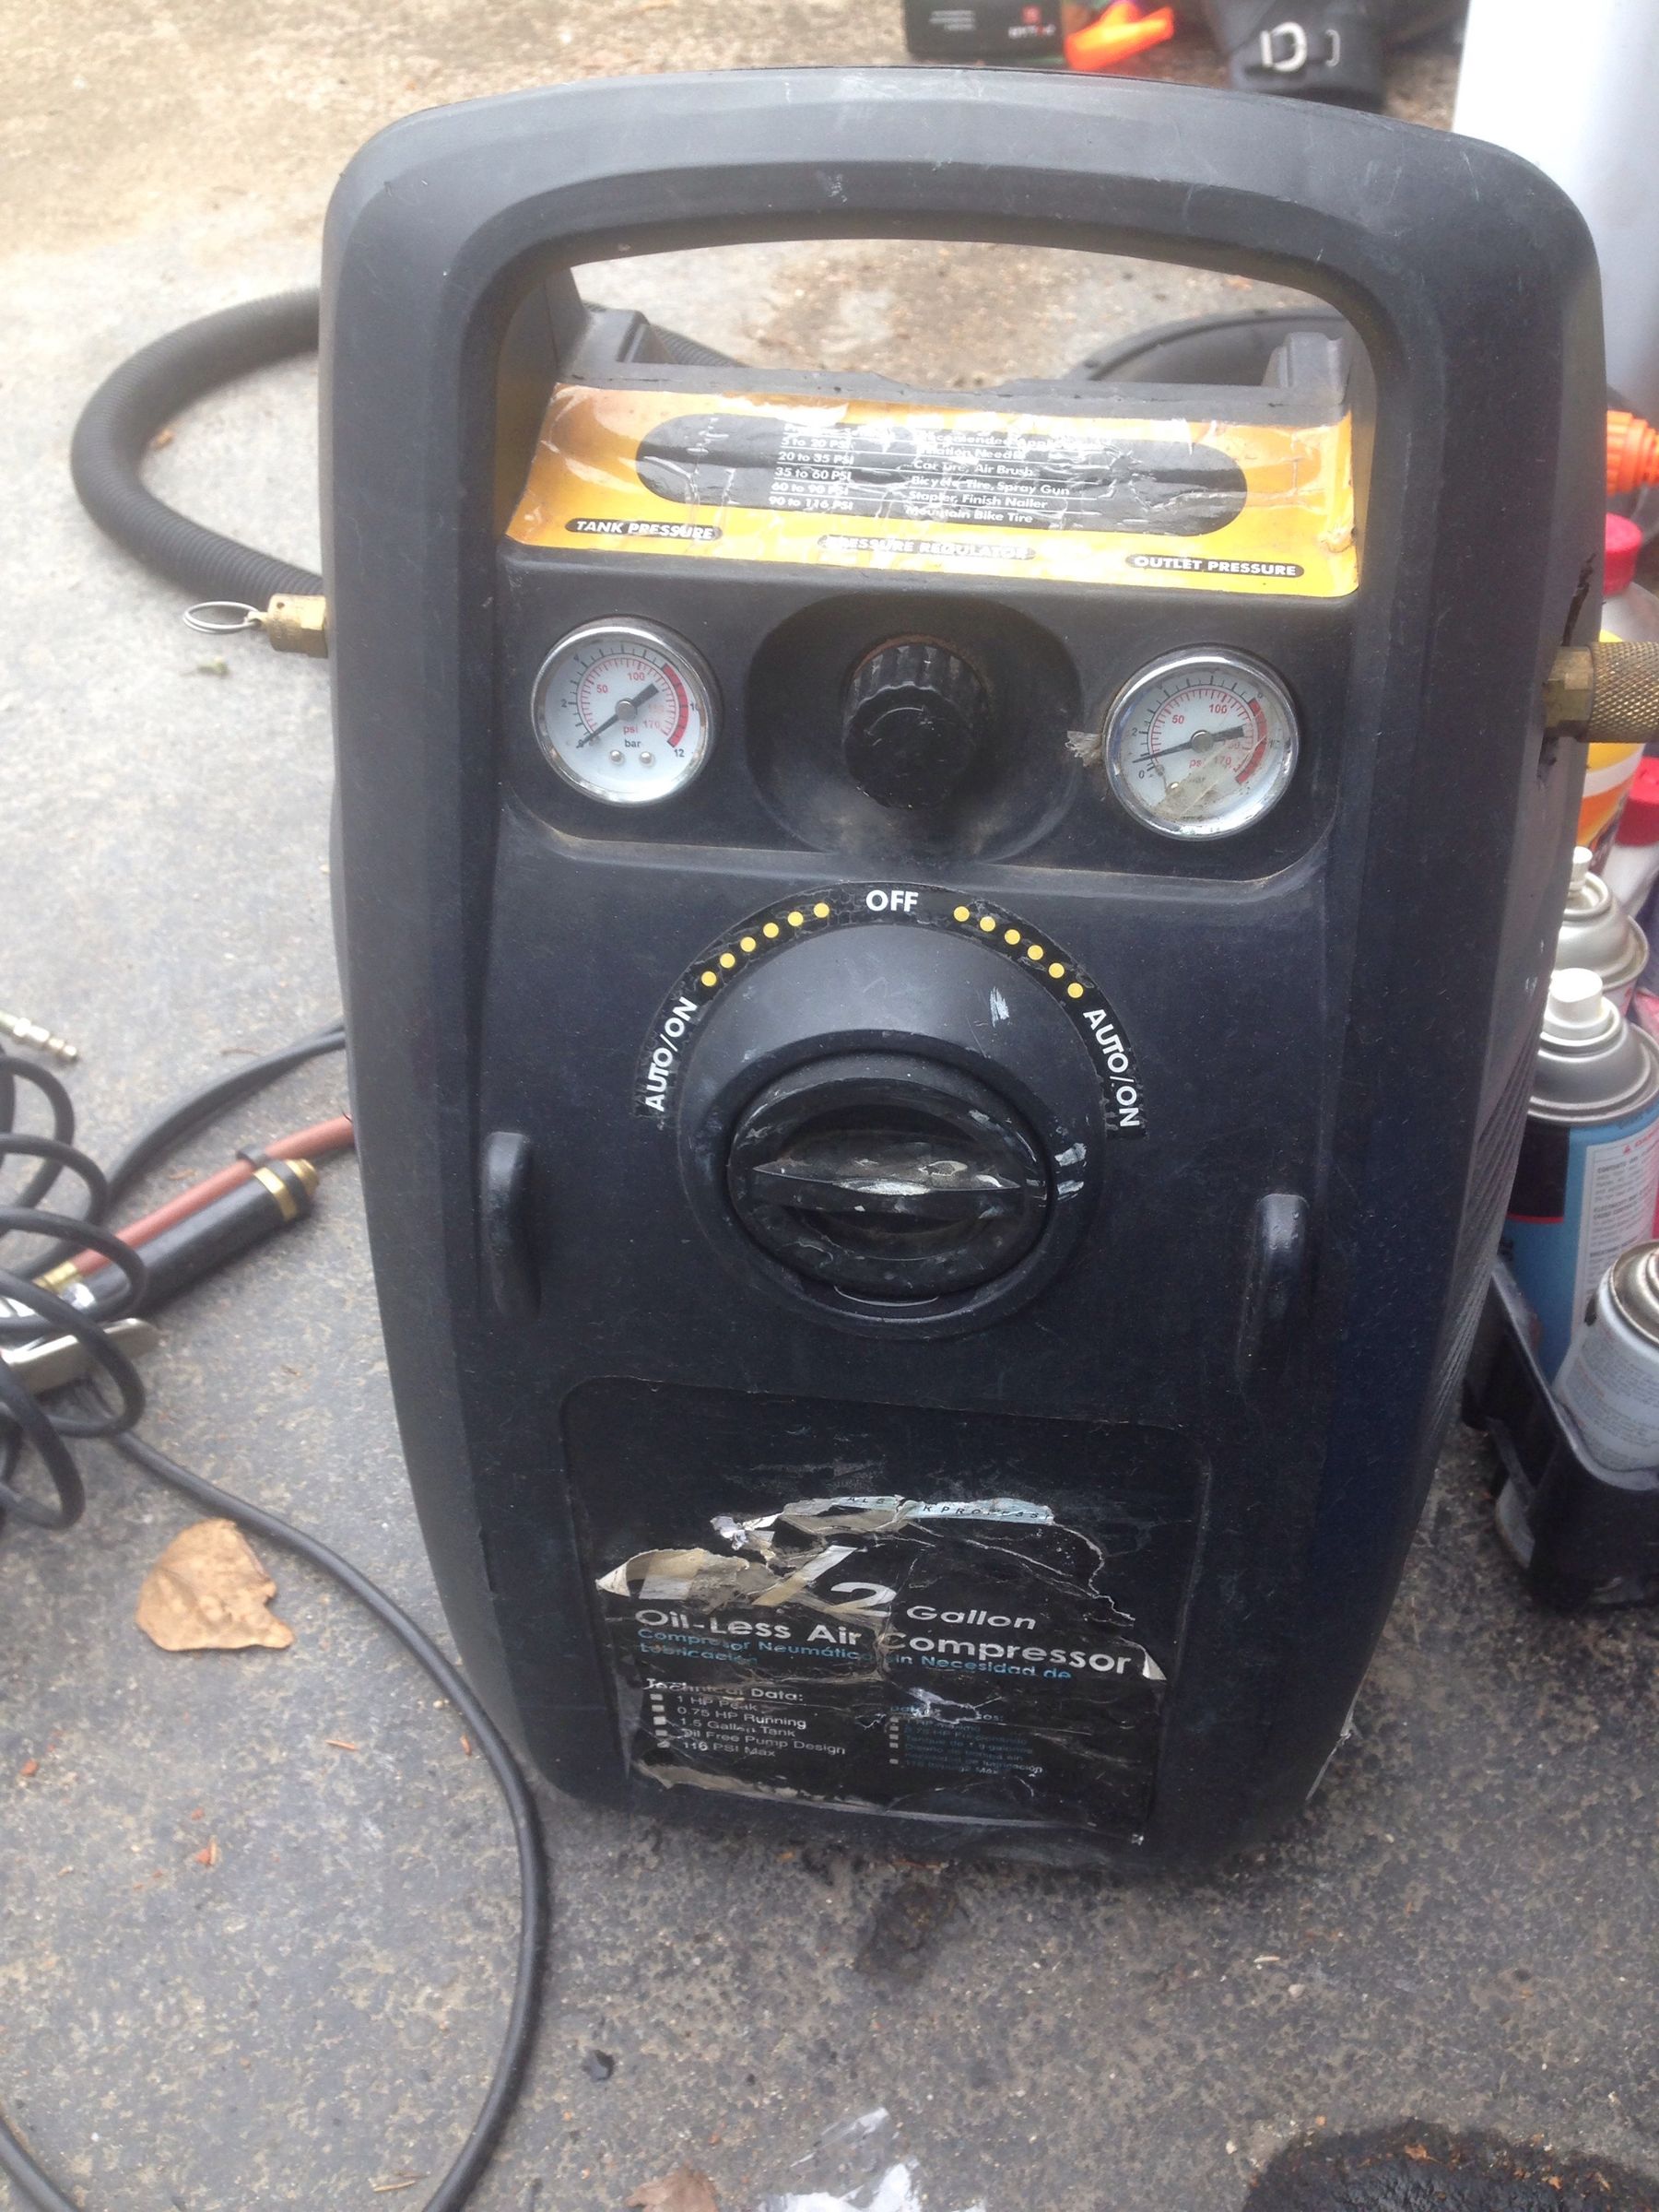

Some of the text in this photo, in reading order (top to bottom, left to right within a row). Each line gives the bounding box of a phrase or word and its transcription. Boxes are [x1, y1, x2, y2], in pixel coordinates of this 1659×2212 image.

[793, 438, 806, 446] to
[811, 439, 827, 448] 20
[830, 440, 852, 450] PSI
[778, 452, 854, 465] 20 to 35 PSI
[775, 466, 852, 481] 35 to 60 PSI
[913, 460, 938, 471] Car
[974, 463, 994, 475] Air
[997, 465, 1033, 477] Brush
[771, 482, 848, 496] 60 to 90 PSI
[965, 478, 994, 491] Tire,
[996, 481, 1036, 496] Spray
[1040, 485, 1070, 496] Gun
[768, 496, 853, 511] 90 to 116 PSI
[908, 490, 1048, 509] Stapler, Finish Nailer
[905, 506, 1033, 524] Mountain Bike Tire
[576, 520, 713, 540] TANK PRESSURE
[826, 535, 1029, 559] PRESSURE REGULATOR
[1133, 555, 1297, 576] OUTLET PRESSURE
[628, 671, 645, 681] 100
[597, 684, 608, 694] 50
[560, 699, 568, 708] 2
[1208, 703, 1228, 714] 100
[1171, 714, 1184, 724] 50
[623, 724, 640, 735] psi
[1132, 727, 1138, 736] 2
[624, 739, 641, 748] bar
[674, 748, 685, 758] 12
[1213, 756, 1232, 766] 170
[1138, 771, 1145, 779] 0
[865, 888, 919, 912] OFF
[644, 996, 698, 1112] AUTO/ON
[1082, 1007, 1140, 1129] AUTO/ON
[906, 1605, 1036, 1630] Gallon
[635, 1609, 1132, 1675] Oil-Less Air Compressor
[922, 1655, 1036, 1677] Necesidad
[1042, 1667, 1072, 1679] de
[750, 1688, 804, 1701] Data:
[690, 1696, 712, 1706] HP
[719, 1699, 758, 1712] Peak
[715, 1709, 738, 1720] HP
[743, 1713, 807, 1730] Running
[707, 1719, 757, 1733] Gallon
[760, 1725, 795, 1737] Tank
[706, 1731, 741, 1744] Free
[745, 1735, 788, 1749] Pump
[794, 1739, 846, 1755] Design
[712, 1743, 739, 1754] PSI
[744, 1746, 775, 1757] Max
